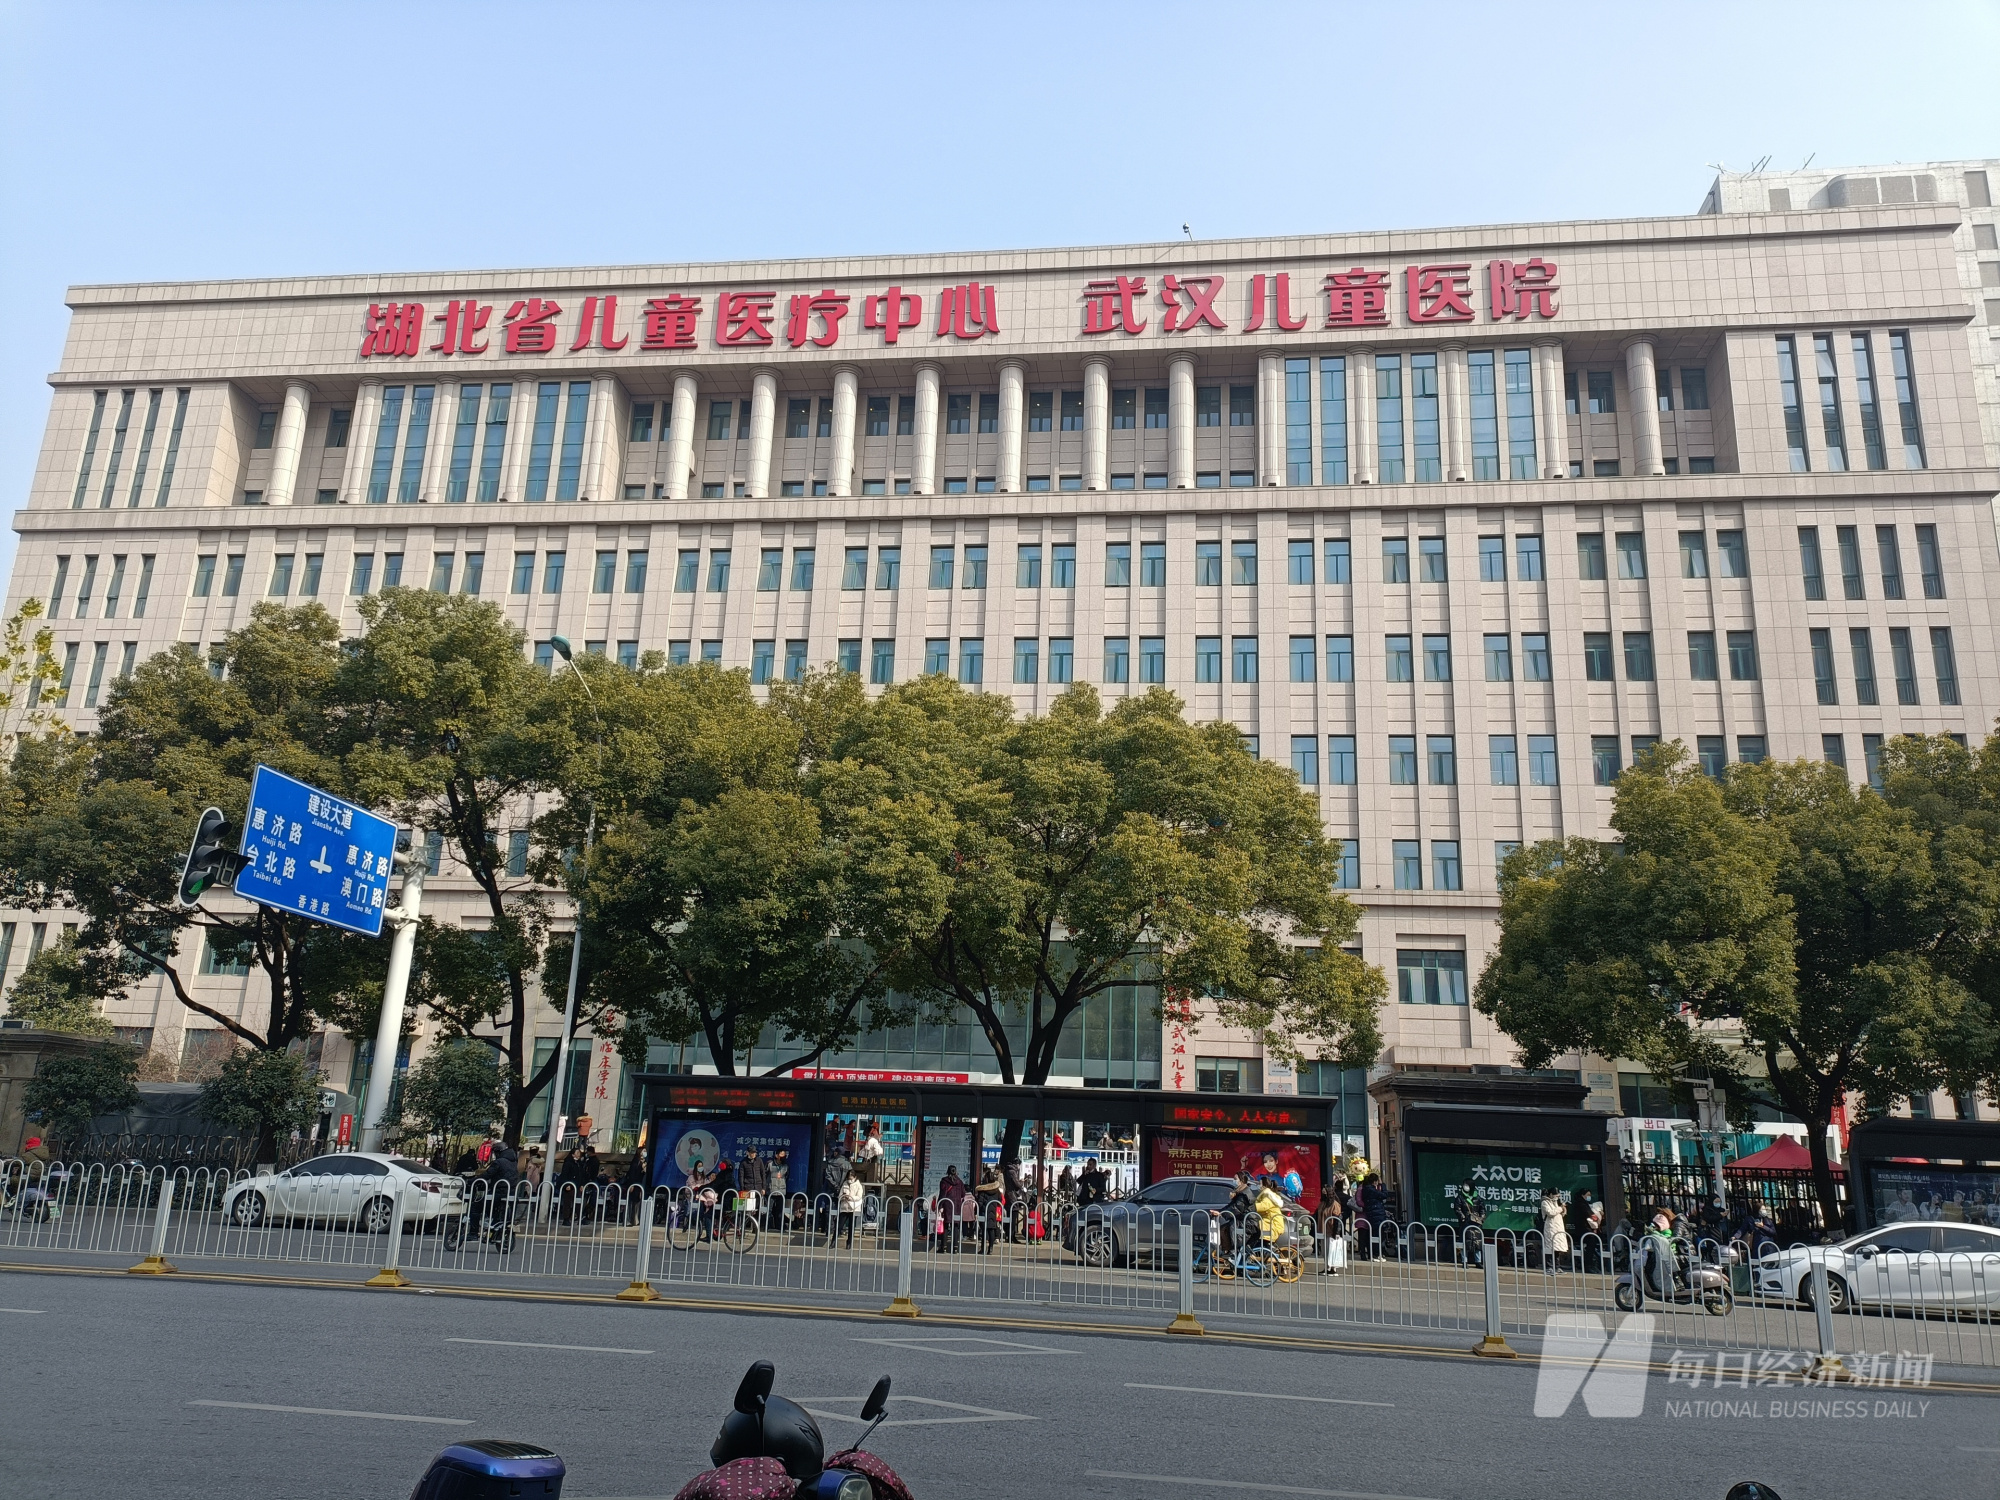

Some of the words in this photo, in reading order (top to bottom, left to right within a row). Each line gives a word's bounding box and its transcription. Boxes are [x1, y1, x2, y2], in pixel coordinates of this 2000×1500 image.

[360, 281, 1000, 358] 湖北省儿童医疗中心
[1082, 257, 1561, 335] 武汉儿童医院
[307, 793, 354, 830] 建设大道
[251, 807, 303, 845] 惠济路
[311, 818, 333, 832] Jianshe
[261, 835, 277, 848] Huiji
[277, 840, 287, 850] Rd.
[246, 844, 297, 880] 台北路
[345, 844, 388, 878] 惠济路
[253, 869, 272, 882] Taibei
[273, 877, 283, 886] Rd.
[340, 876, 383, 908] 澳门路
[298, 894, 331, 916] 香港路
[1644, 1119, 1665, 1130] 出口
[1168, 1148, 1224, 1160] 京东年货节
[1644, 1142, 1653, 1158] 出口
[1471, 1164, 1542, 1183] 大众口腔
